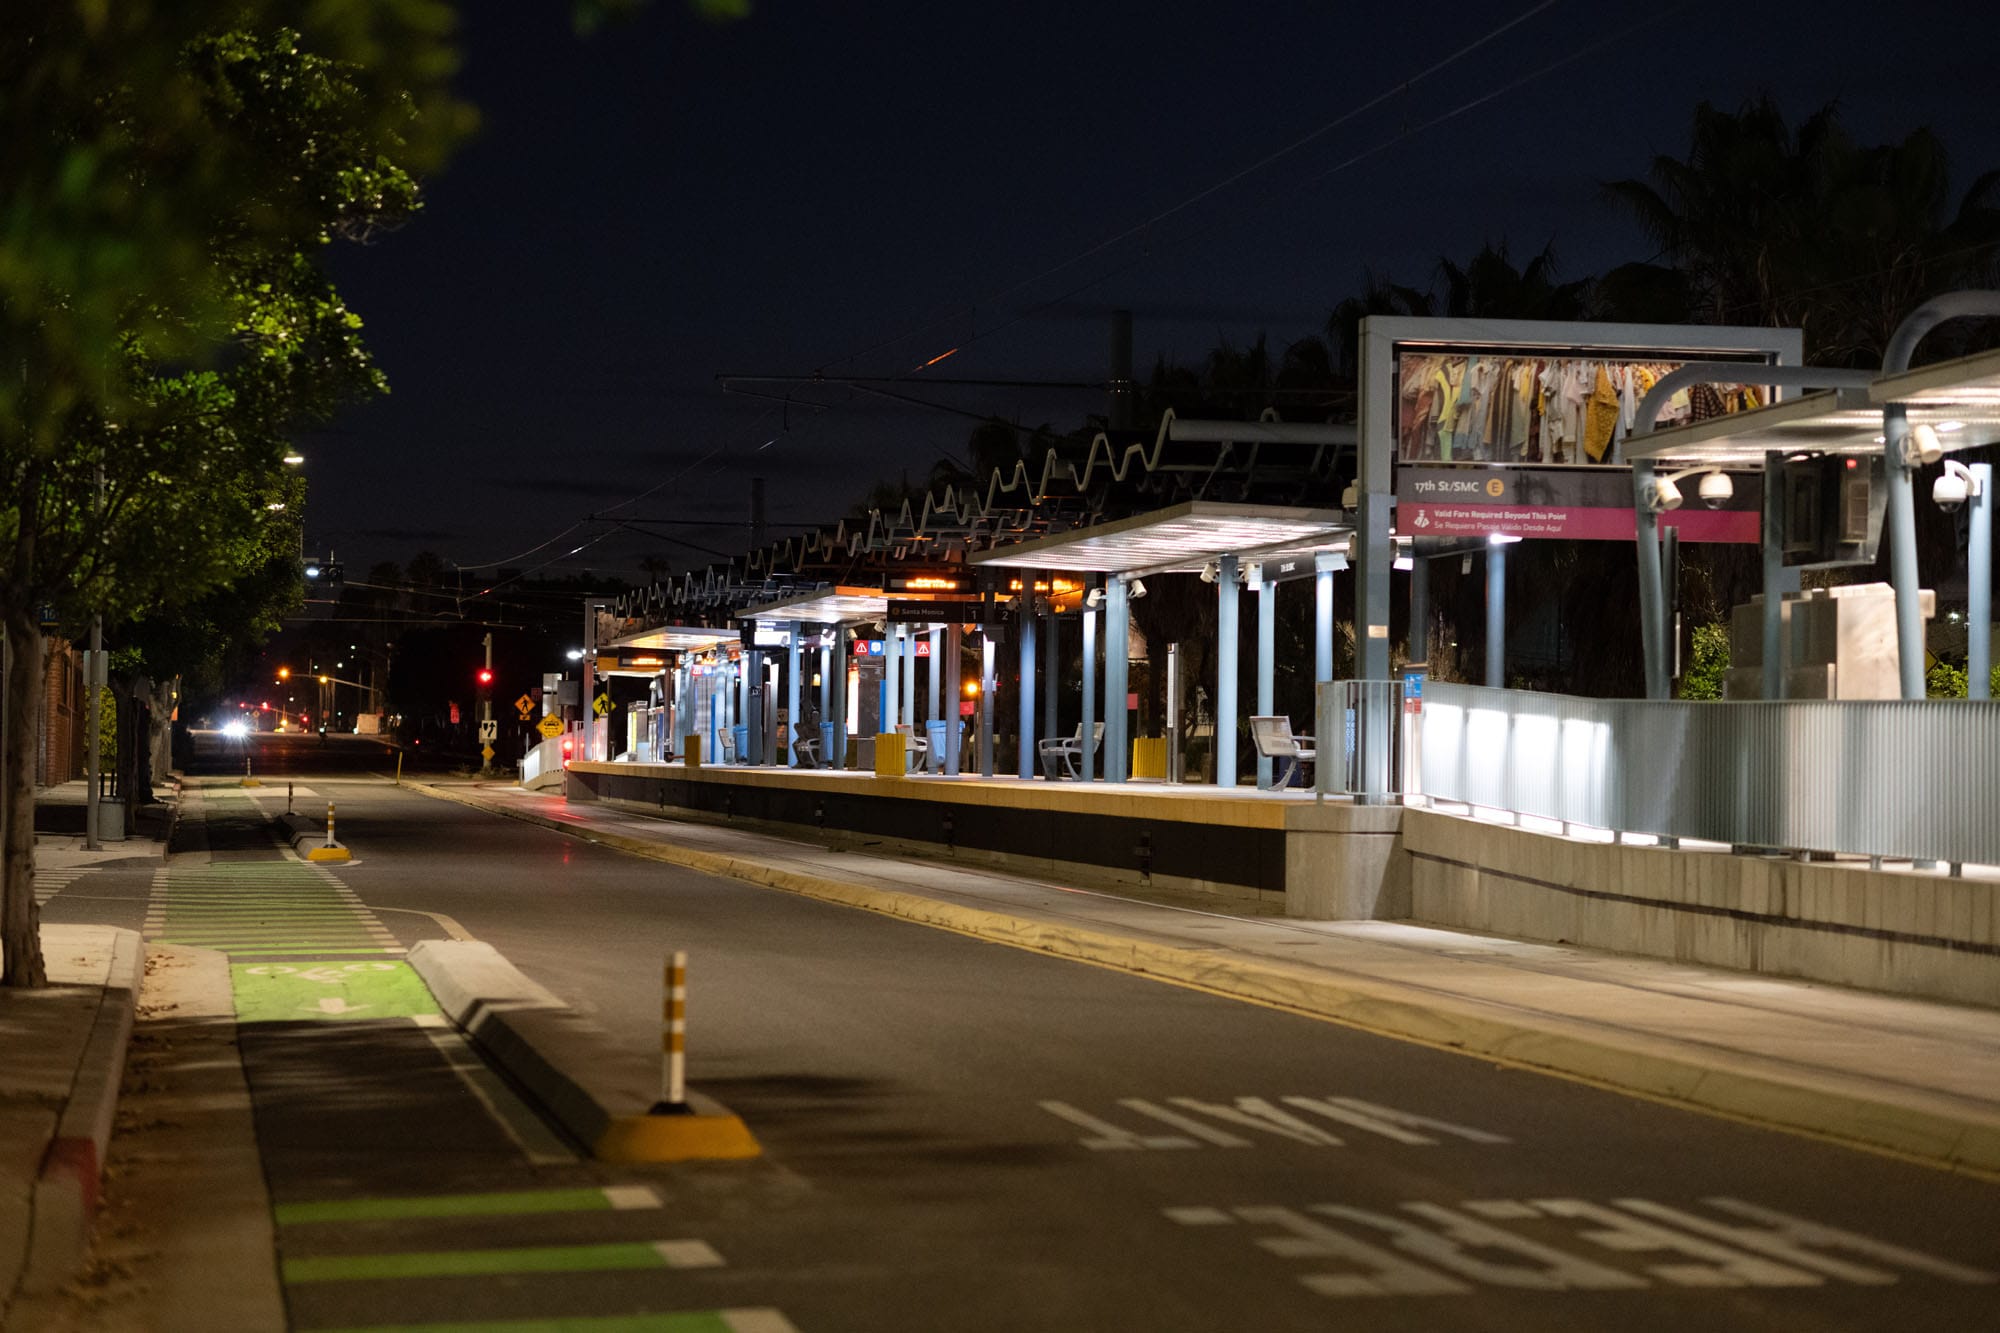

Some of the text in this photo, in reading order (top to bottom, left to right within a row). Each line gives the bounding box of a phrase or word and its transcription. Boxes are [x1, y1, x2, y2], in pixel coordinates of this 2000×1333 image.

[1414, 480, 1499, 494] 17th St/SMC E
[1434, 510, 1567, 521] Valid Fare Required Beyond This Point
[1434, 521, 1444, 529] Se
[1445, 521, 1476, 530] Requiere
[1523, 523, 1545, 531] Desde
[901, 607, 920, 616] Santa
[921, 607, 945, 616] Monica
[1037, 1094, 1513, 1151] WAIT
[1164, 1196, 1996, 1298] HERE
